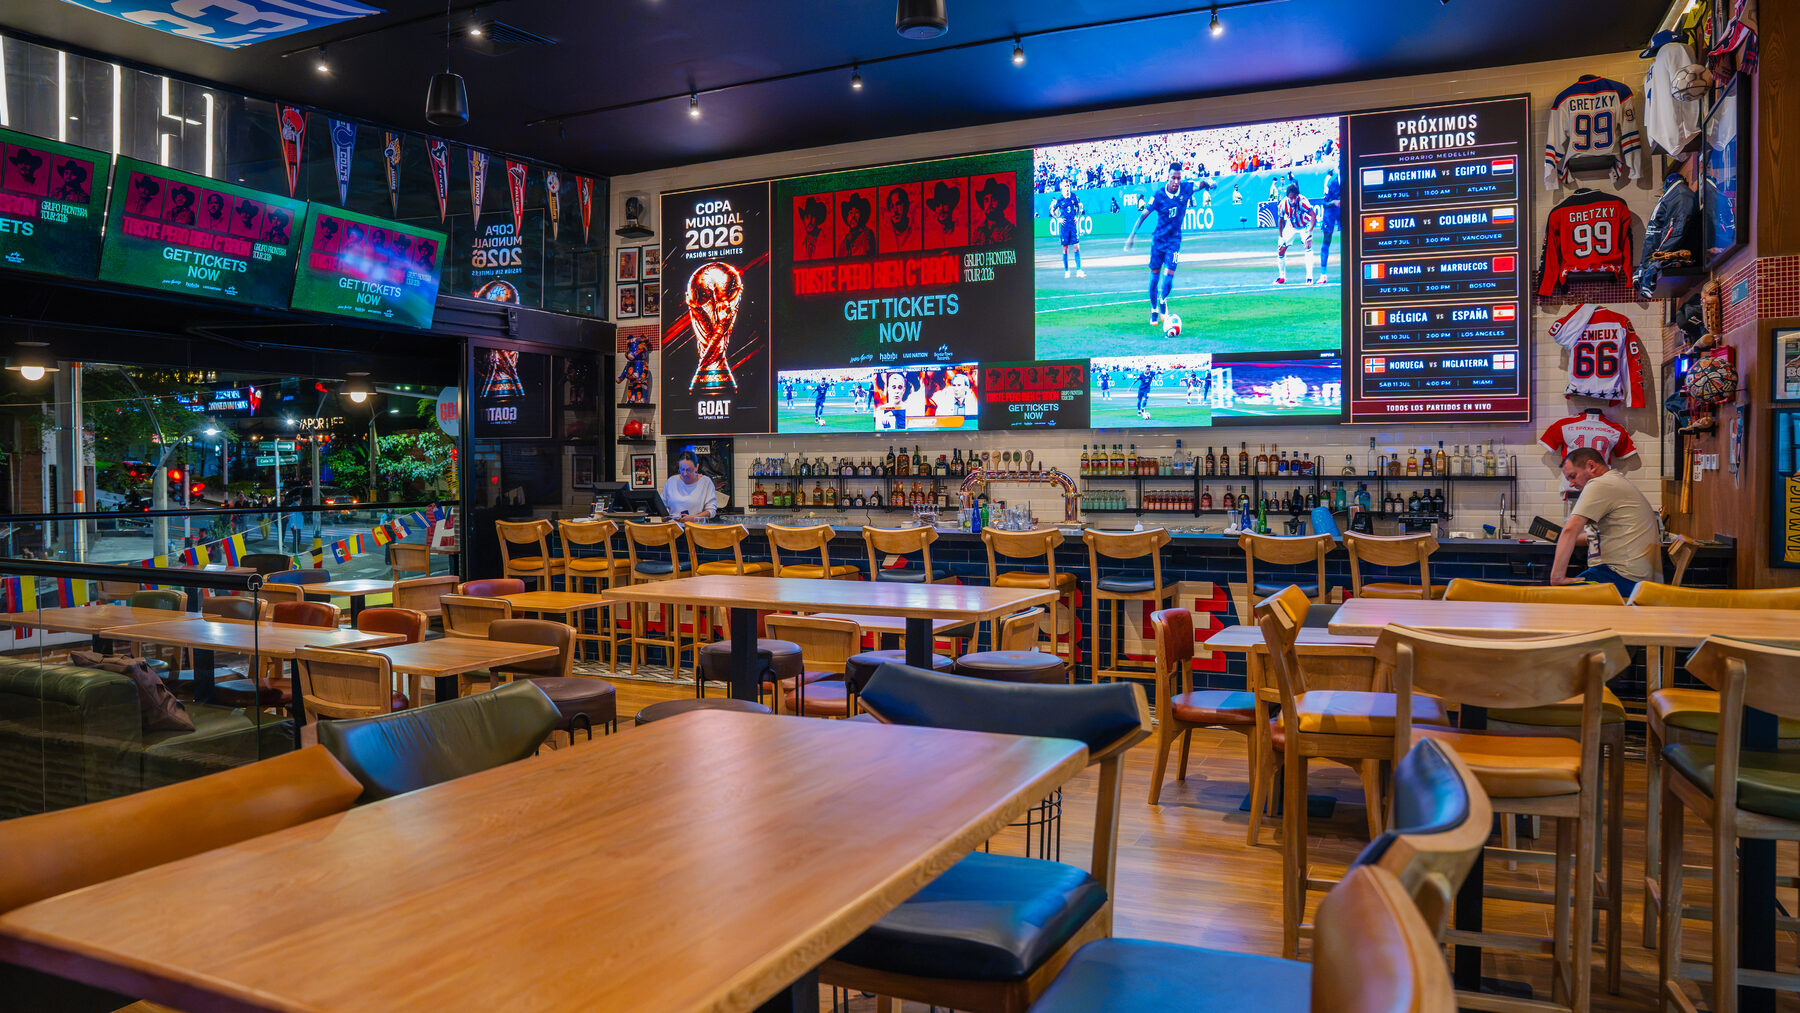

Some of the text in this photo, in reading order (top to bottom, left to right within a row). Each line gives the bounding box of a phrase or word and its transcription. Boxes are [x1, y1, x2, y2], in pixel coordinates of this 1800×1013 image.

[1569, 95, 1616, 111] GRETZKY
[1397, 114, 1477, 135] PRÓXIMOS
[1573, 111, 1614, 152] 99
[1399, 131, 1475, 152] PARTIDOS
[1399, 153, 1434, 162] HORARIO
[340, 151, 348, 181] COLTS
[1388, 169, 1437, 182] ARGENTINA
[1455, 165, 1487, 176] EGIPTO
[695, 200, 732, 215] COPA
[1123, 193, 1138, 206] FIFA
[685, 213, 744, 229] MUNDIAL
[1389, 218, 1416, 229] SUIZA
[1439, 213, 1488, 226] COLOMBIA
[1569, 207, 1615, 223] GRETZKY
[1050, 216, 1093, 235] arco
[685, 225, 744, 251] 2026
[1462, 233, 1503, 241] VANCOUVER
[1573, 220, 1613, 259] 99
[163, 247, 247, 273] GET TICKETS
[685, 251, 707, 260] PASIÓN
[719, 248, 743, 257] LÍMITES
[964, 248, 1017, 267] GRUPO FRONTERA
[187, 266, 220, 282] NOW
[964, 266, 995, 283] TOUR 2026
[1389, 265, 1422, 275] FRANCIA
[1440, 262, 1488, 272] MARRUECOS
[339, 277, 402, 298] GET TICKETS
[793, 267, 836, 296] TRISTE
[838, 263, 871, 292] PERO
[356, 292, 381, 306] NOW
[844, 293, 959, 321] GET TICKETS
[1389, 311, 1428, 324] BÉLGICA
[1452, 308, 1488, 321] ESPAÑA
[879, 321, 922, 344] NOW
[1577, 328, 1618, 341] EMIEUX
[1389, 360, 1424, 369] NORUEGA
[1442, 359, 1488, 368] INGLATERRA
[1573, 341, 1619, 379] 66
[698, 400, 731, 416] GOAT
[1008, 403, 1060, 412] GET TICKETS
[1474, 402, 1492, 410] VIVO
[1024, 411, 1043, 419] NOW
[300, 418, 325, 430] VAPOR
[1573, 434, 1610, 451] 10
